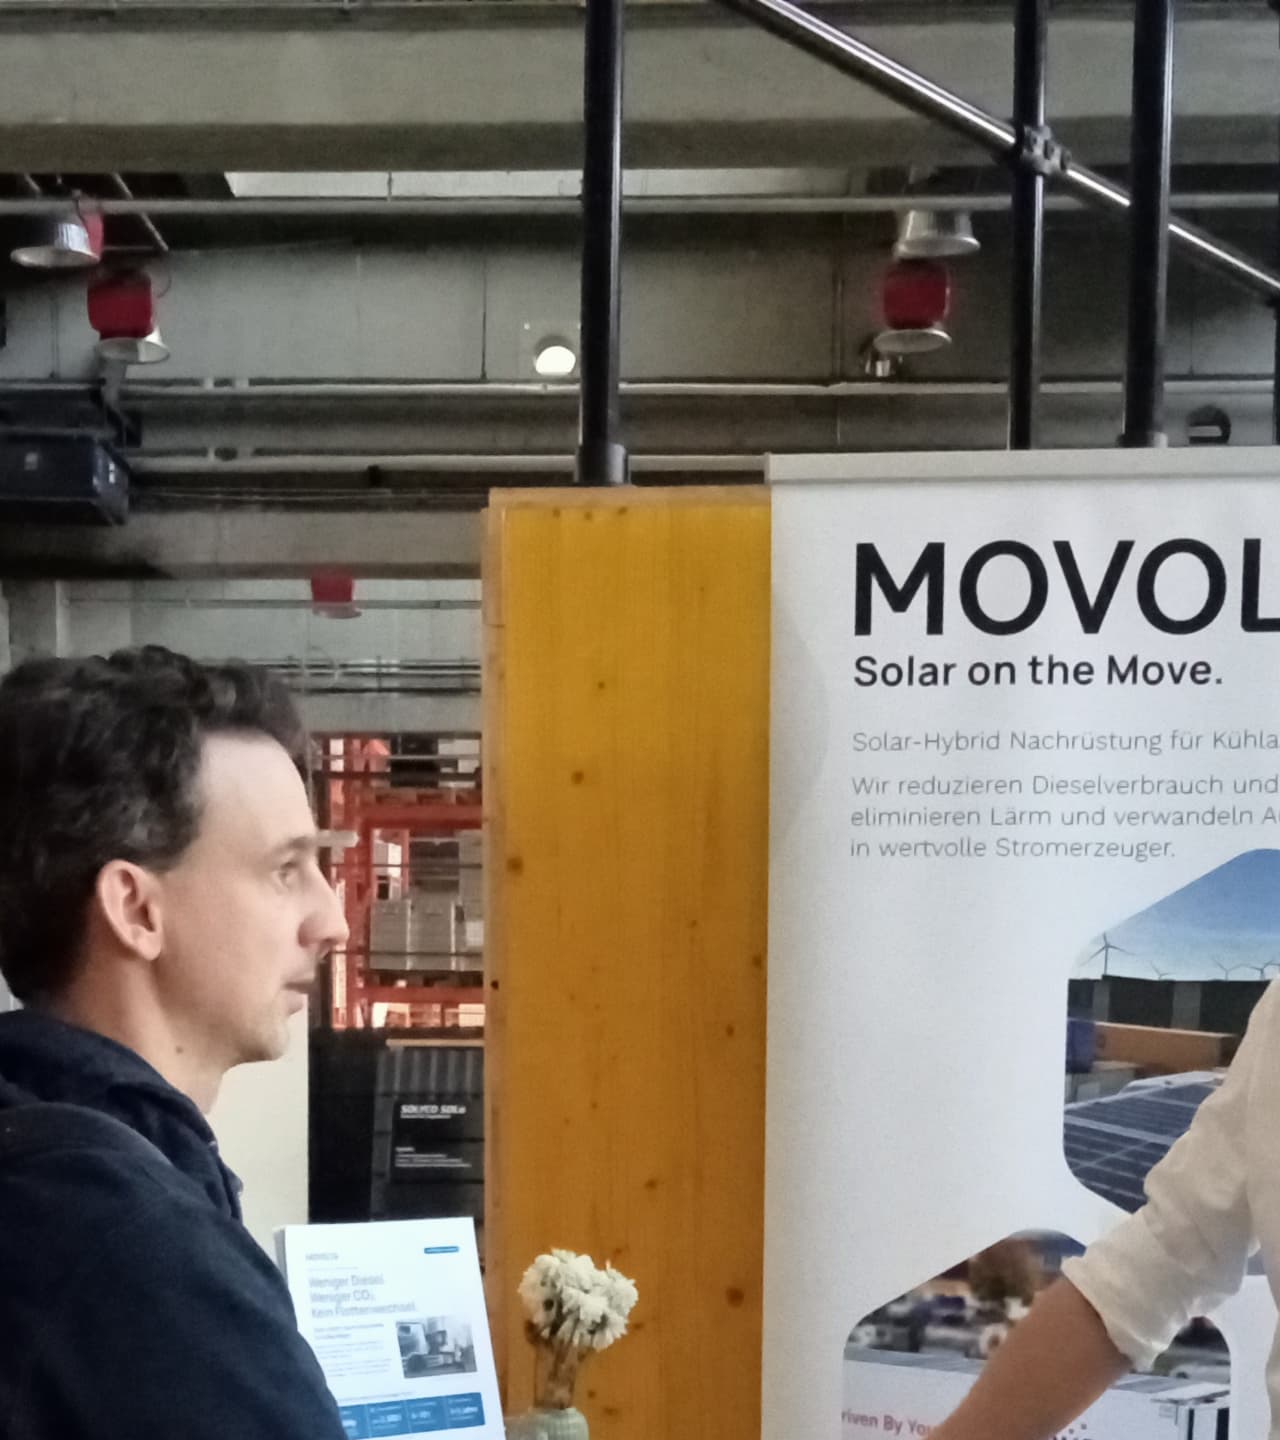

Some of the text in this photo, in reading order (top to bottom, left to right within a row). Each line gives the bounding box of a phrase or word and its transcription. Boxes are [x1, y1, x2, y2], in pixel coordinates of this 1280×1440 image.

[854, 654, 1222, 687] Solar on the Move.
[852, 729, 1001, 757] Solar-Hybrid
[1010, 730, 1163, 757] Nachrüstung
[1170, 727, 1204, 751] für
[851, 776, 891, 796] Wir
[898, 775, 1023, 796] reduzieren
[1032, 774, 1224, 796] Dieselverbrauch
[1232, 773, 1279, 795] und
[850, 806, 981, 827] eliminieren
[990, 807, 1052, 827] Lärm
[1060, 806, 1106, 827] und
[1113, 805, 1254, 827] verwandeln
[850, 835, 1175, 864] in wertvolle Stromerzeuger.
[841, 1409, 879, 1429] riven
[883, 1414, 903, 1436] By
